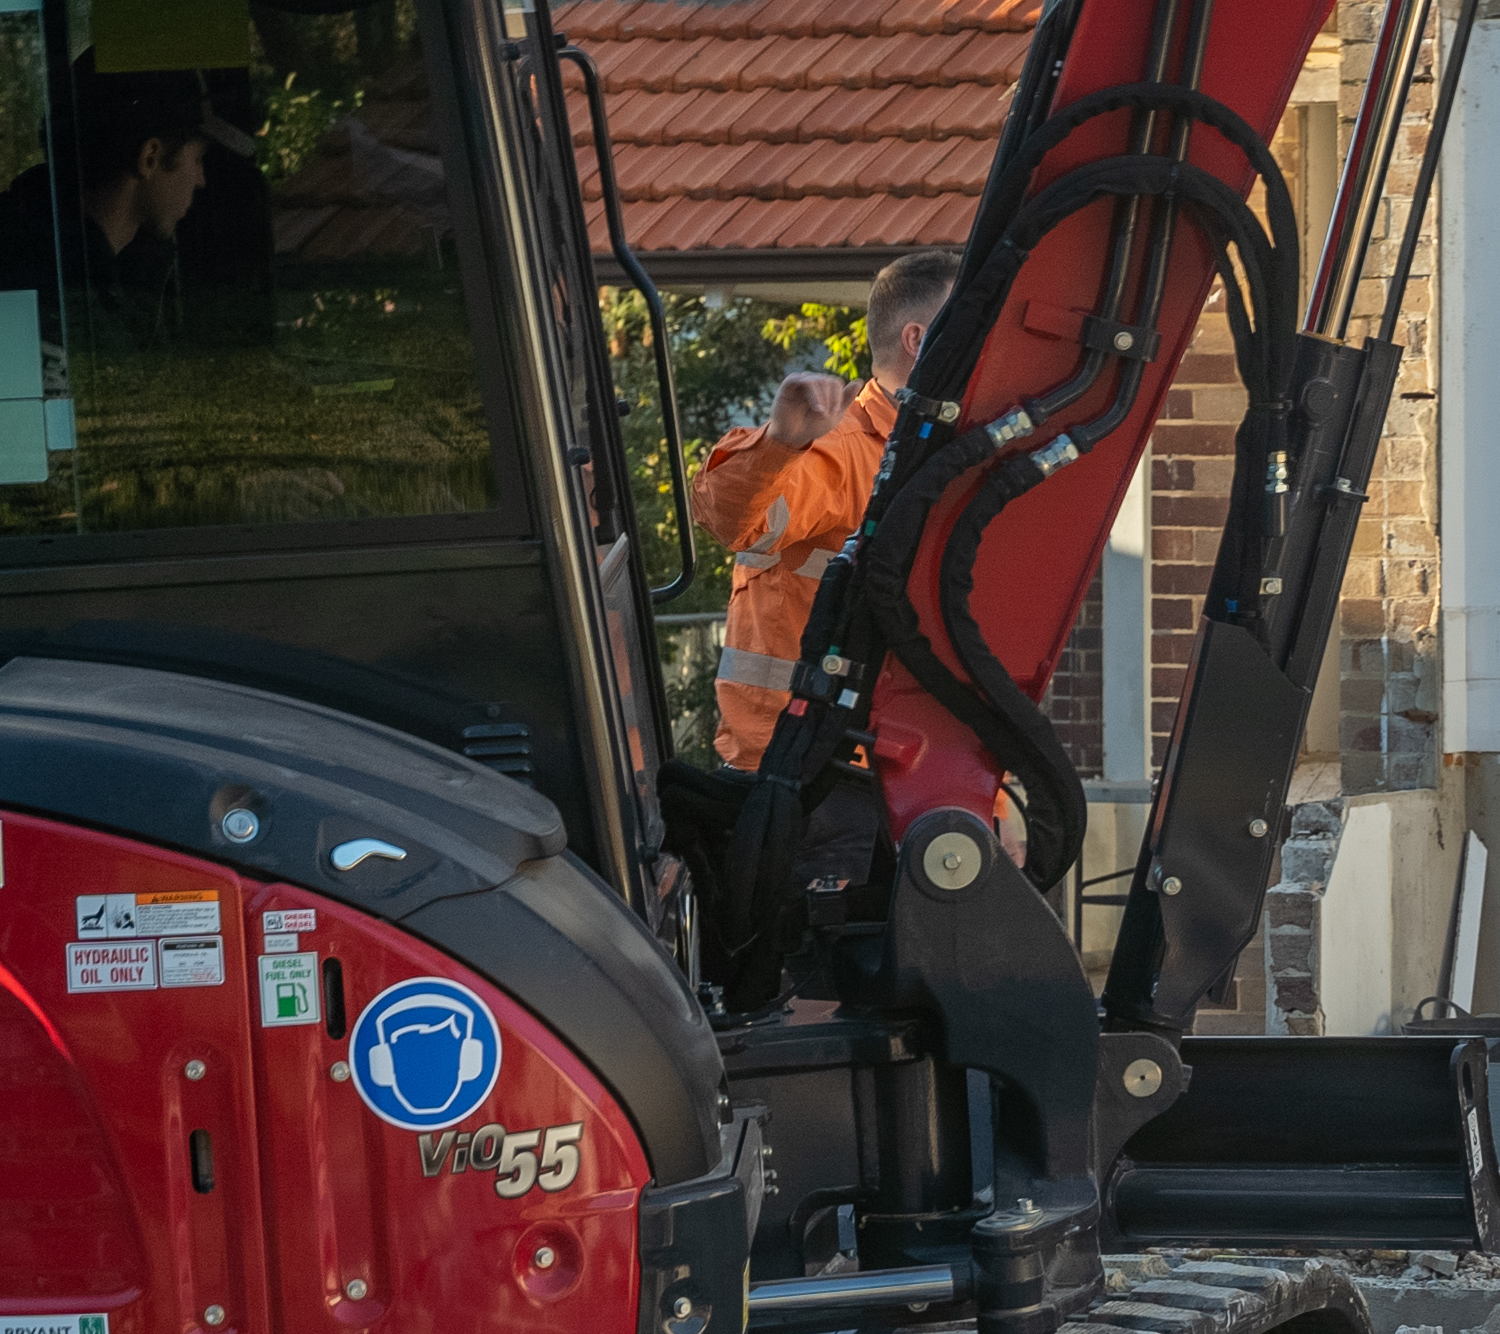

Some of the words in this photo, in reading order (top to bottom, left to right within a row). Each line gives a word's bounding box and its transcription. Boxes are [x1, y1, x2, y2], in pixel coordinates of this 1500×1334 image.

[73, 947, 149, 966] HYDRAULIC
[272, 958, 303, 970] DIESEL
[80, 968, 102, 985] OIL
[110, 967, 144, 983] ONLY
[265, 971, 288, 982] FUEL
[289, 969, 312, 980] ONLY
